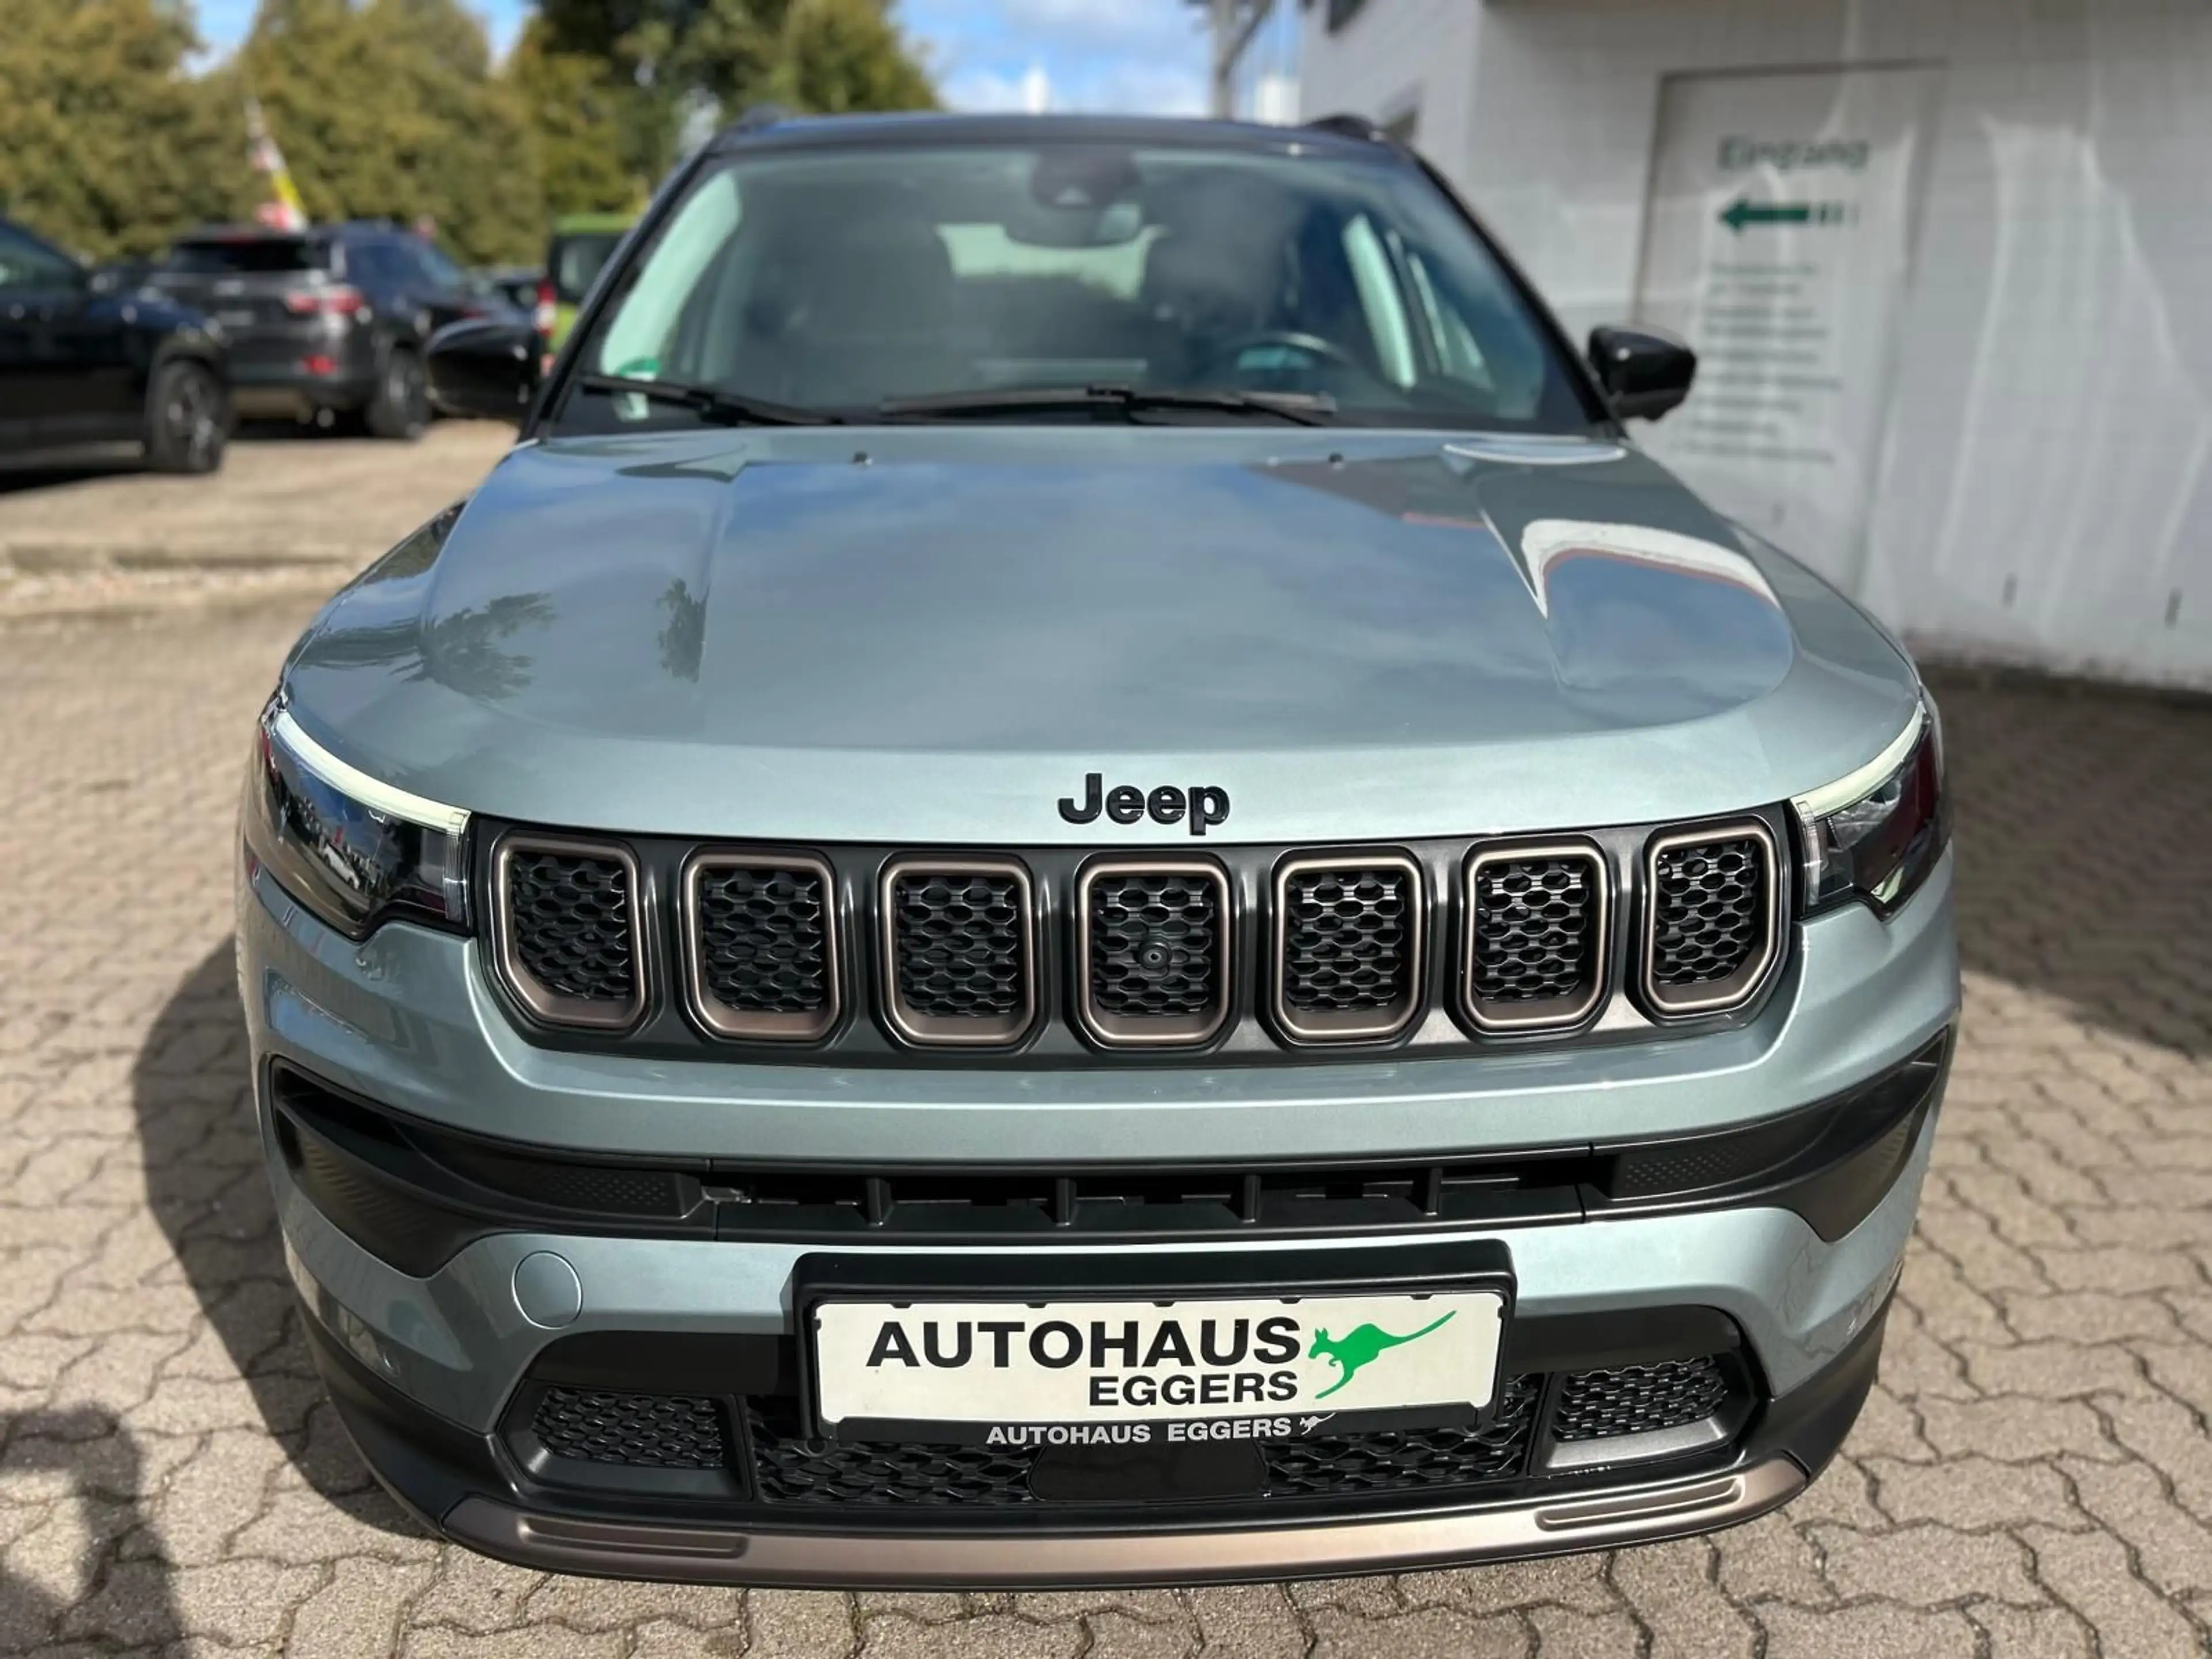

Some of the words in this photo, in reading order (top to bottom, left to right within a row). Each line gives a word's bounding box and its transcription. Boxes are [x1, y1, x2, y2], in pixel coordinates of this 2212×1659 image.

[1058, 772, 1230, 836] Jeep
[865, 1316, 1301, 1369] AUTOHAUS
[1089, 1370, 1298, 1407] EGGERS
[986, 1426, 1152, 1445] AUTOHAUS
[1167, 1417, 1291, 1442] EGGERS
